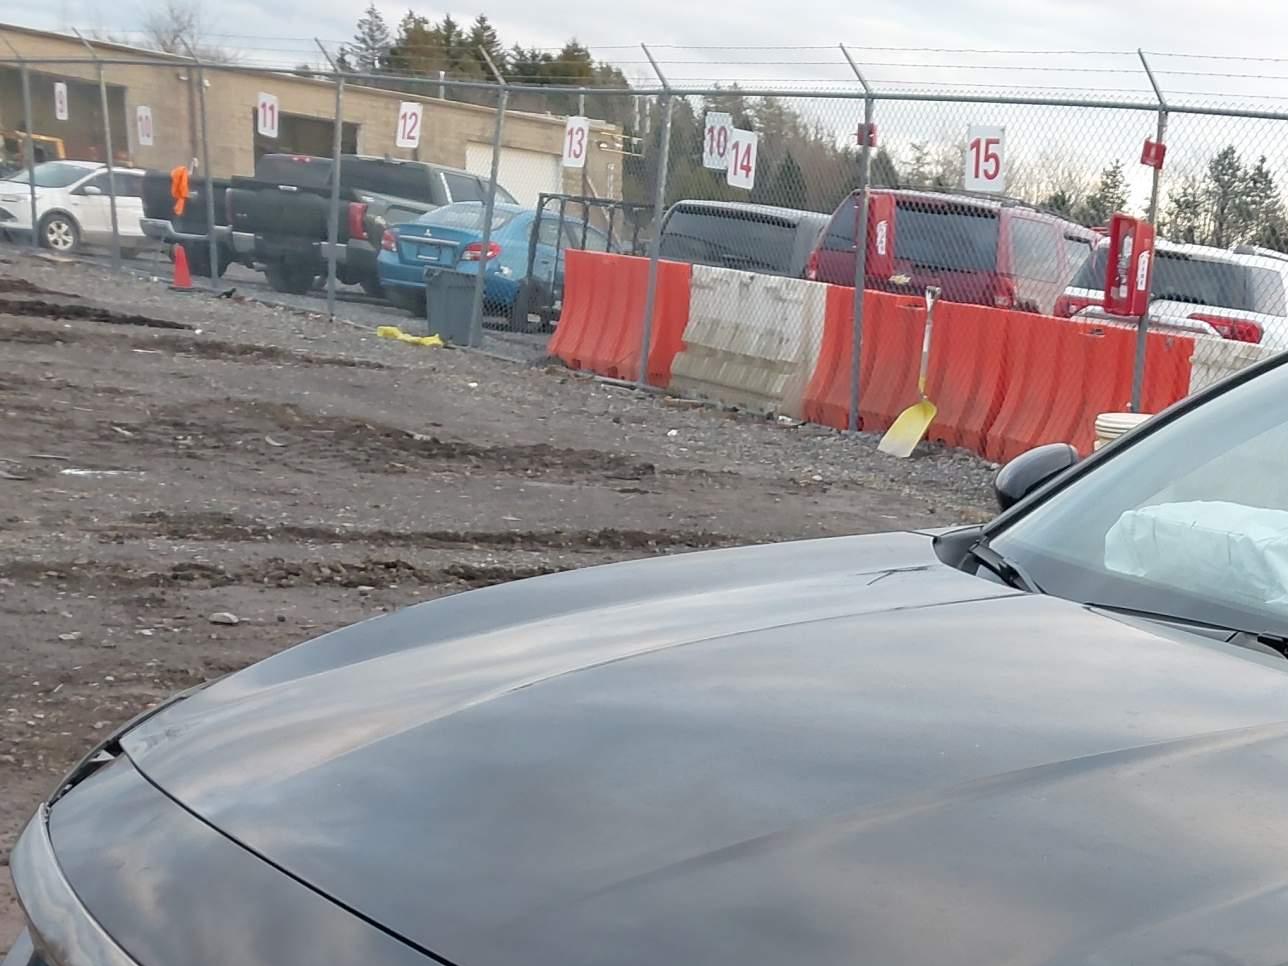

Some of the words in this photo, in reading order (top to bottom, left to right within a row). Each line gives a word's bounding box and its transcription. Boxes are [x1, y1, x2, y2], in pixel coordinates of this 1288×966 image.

[260, 101, 275, 130] 11
[401, 112, 418, 140] 12
[567, 127, 586, 159] 13
[707, 126, 728, 158] 10
[731, 141, 752, 178] 14
[969, 138, 1000, 180] 15
